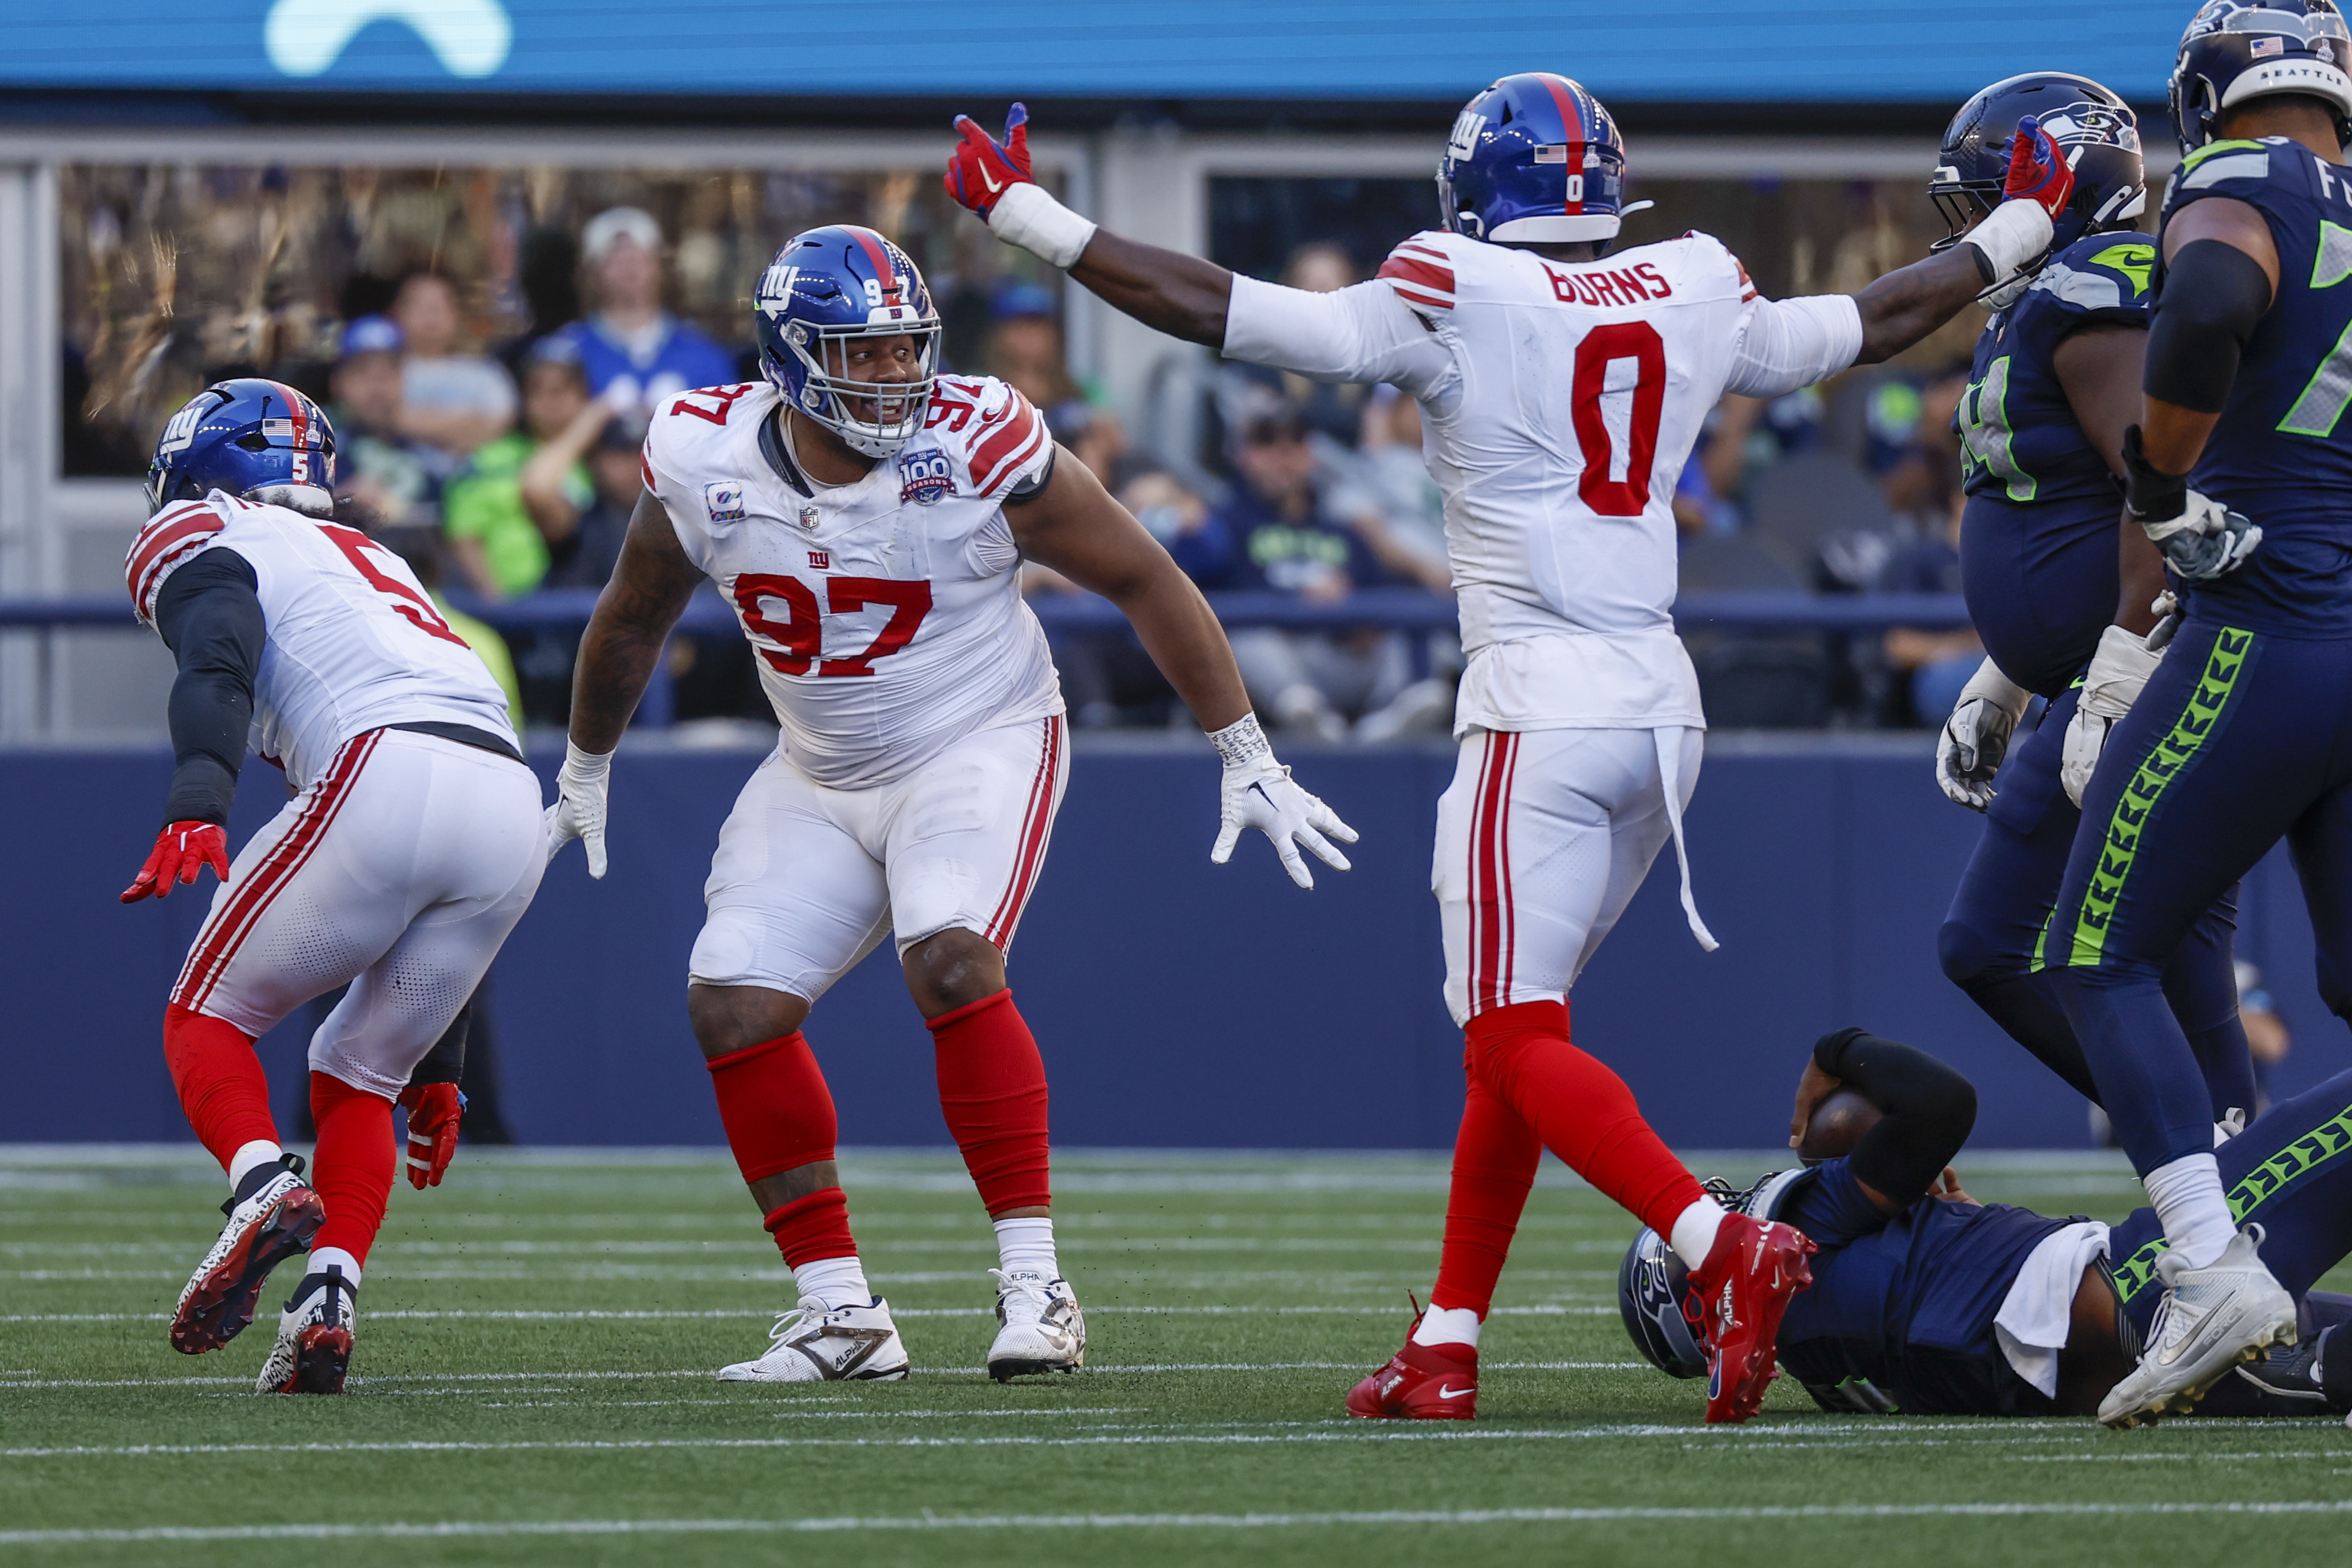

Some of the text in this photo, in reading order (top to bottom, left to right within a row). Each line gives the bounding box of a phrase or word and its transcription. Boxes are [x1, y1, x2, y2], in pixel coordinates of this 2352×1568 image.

[2260, 69, 2343, 86] SEATTLE
[1566, 175, 1583, 202] 0
[863, 276, 910, 307] 97
[1571, 320, 1666, 516] 0
[292, 450, 308, 481] 5
[899, 457, 951, 486] 100
[907, 479, 948, 491] SEASONS
[802, 516, 817, 526] NFL
[807, 551, 829, 569] ny
[312, 523, 471, 651] 5
[733, 572, 934, 677] 97
[1723, 1279, 1733, 1326] ALPHA
[835, 1341, 865, 1369] ALPHA
